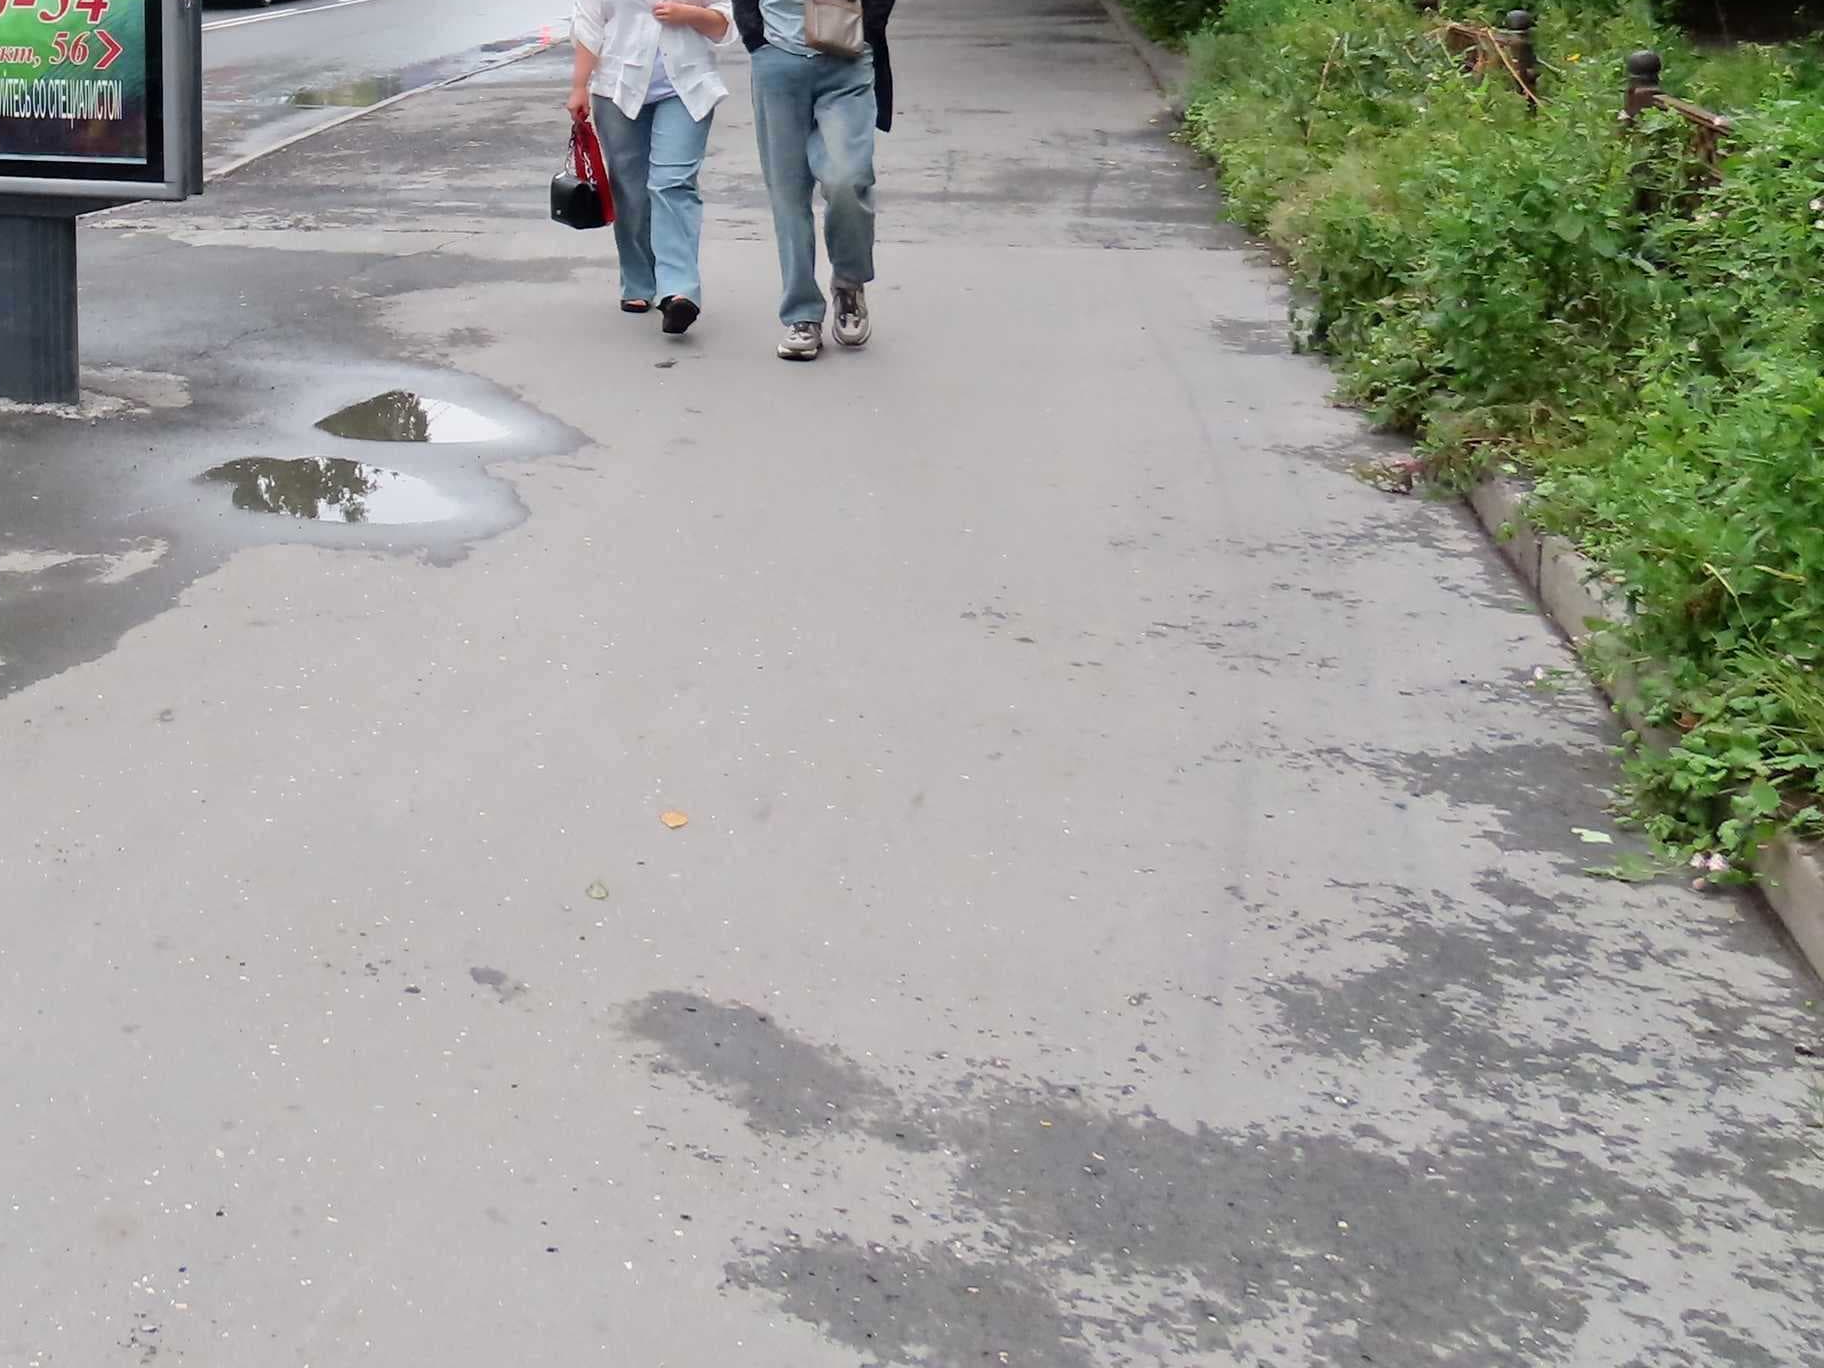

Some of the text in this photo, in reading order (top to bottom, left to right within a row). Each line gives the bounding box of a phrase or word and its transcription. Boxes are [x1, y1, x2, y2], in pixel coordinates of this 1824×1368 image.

[49, 31, 90, 65] 56
[33, 79, 46, 119] СО
[48, 79, 123, 128] СПЕЦИАЛИСТОМ
